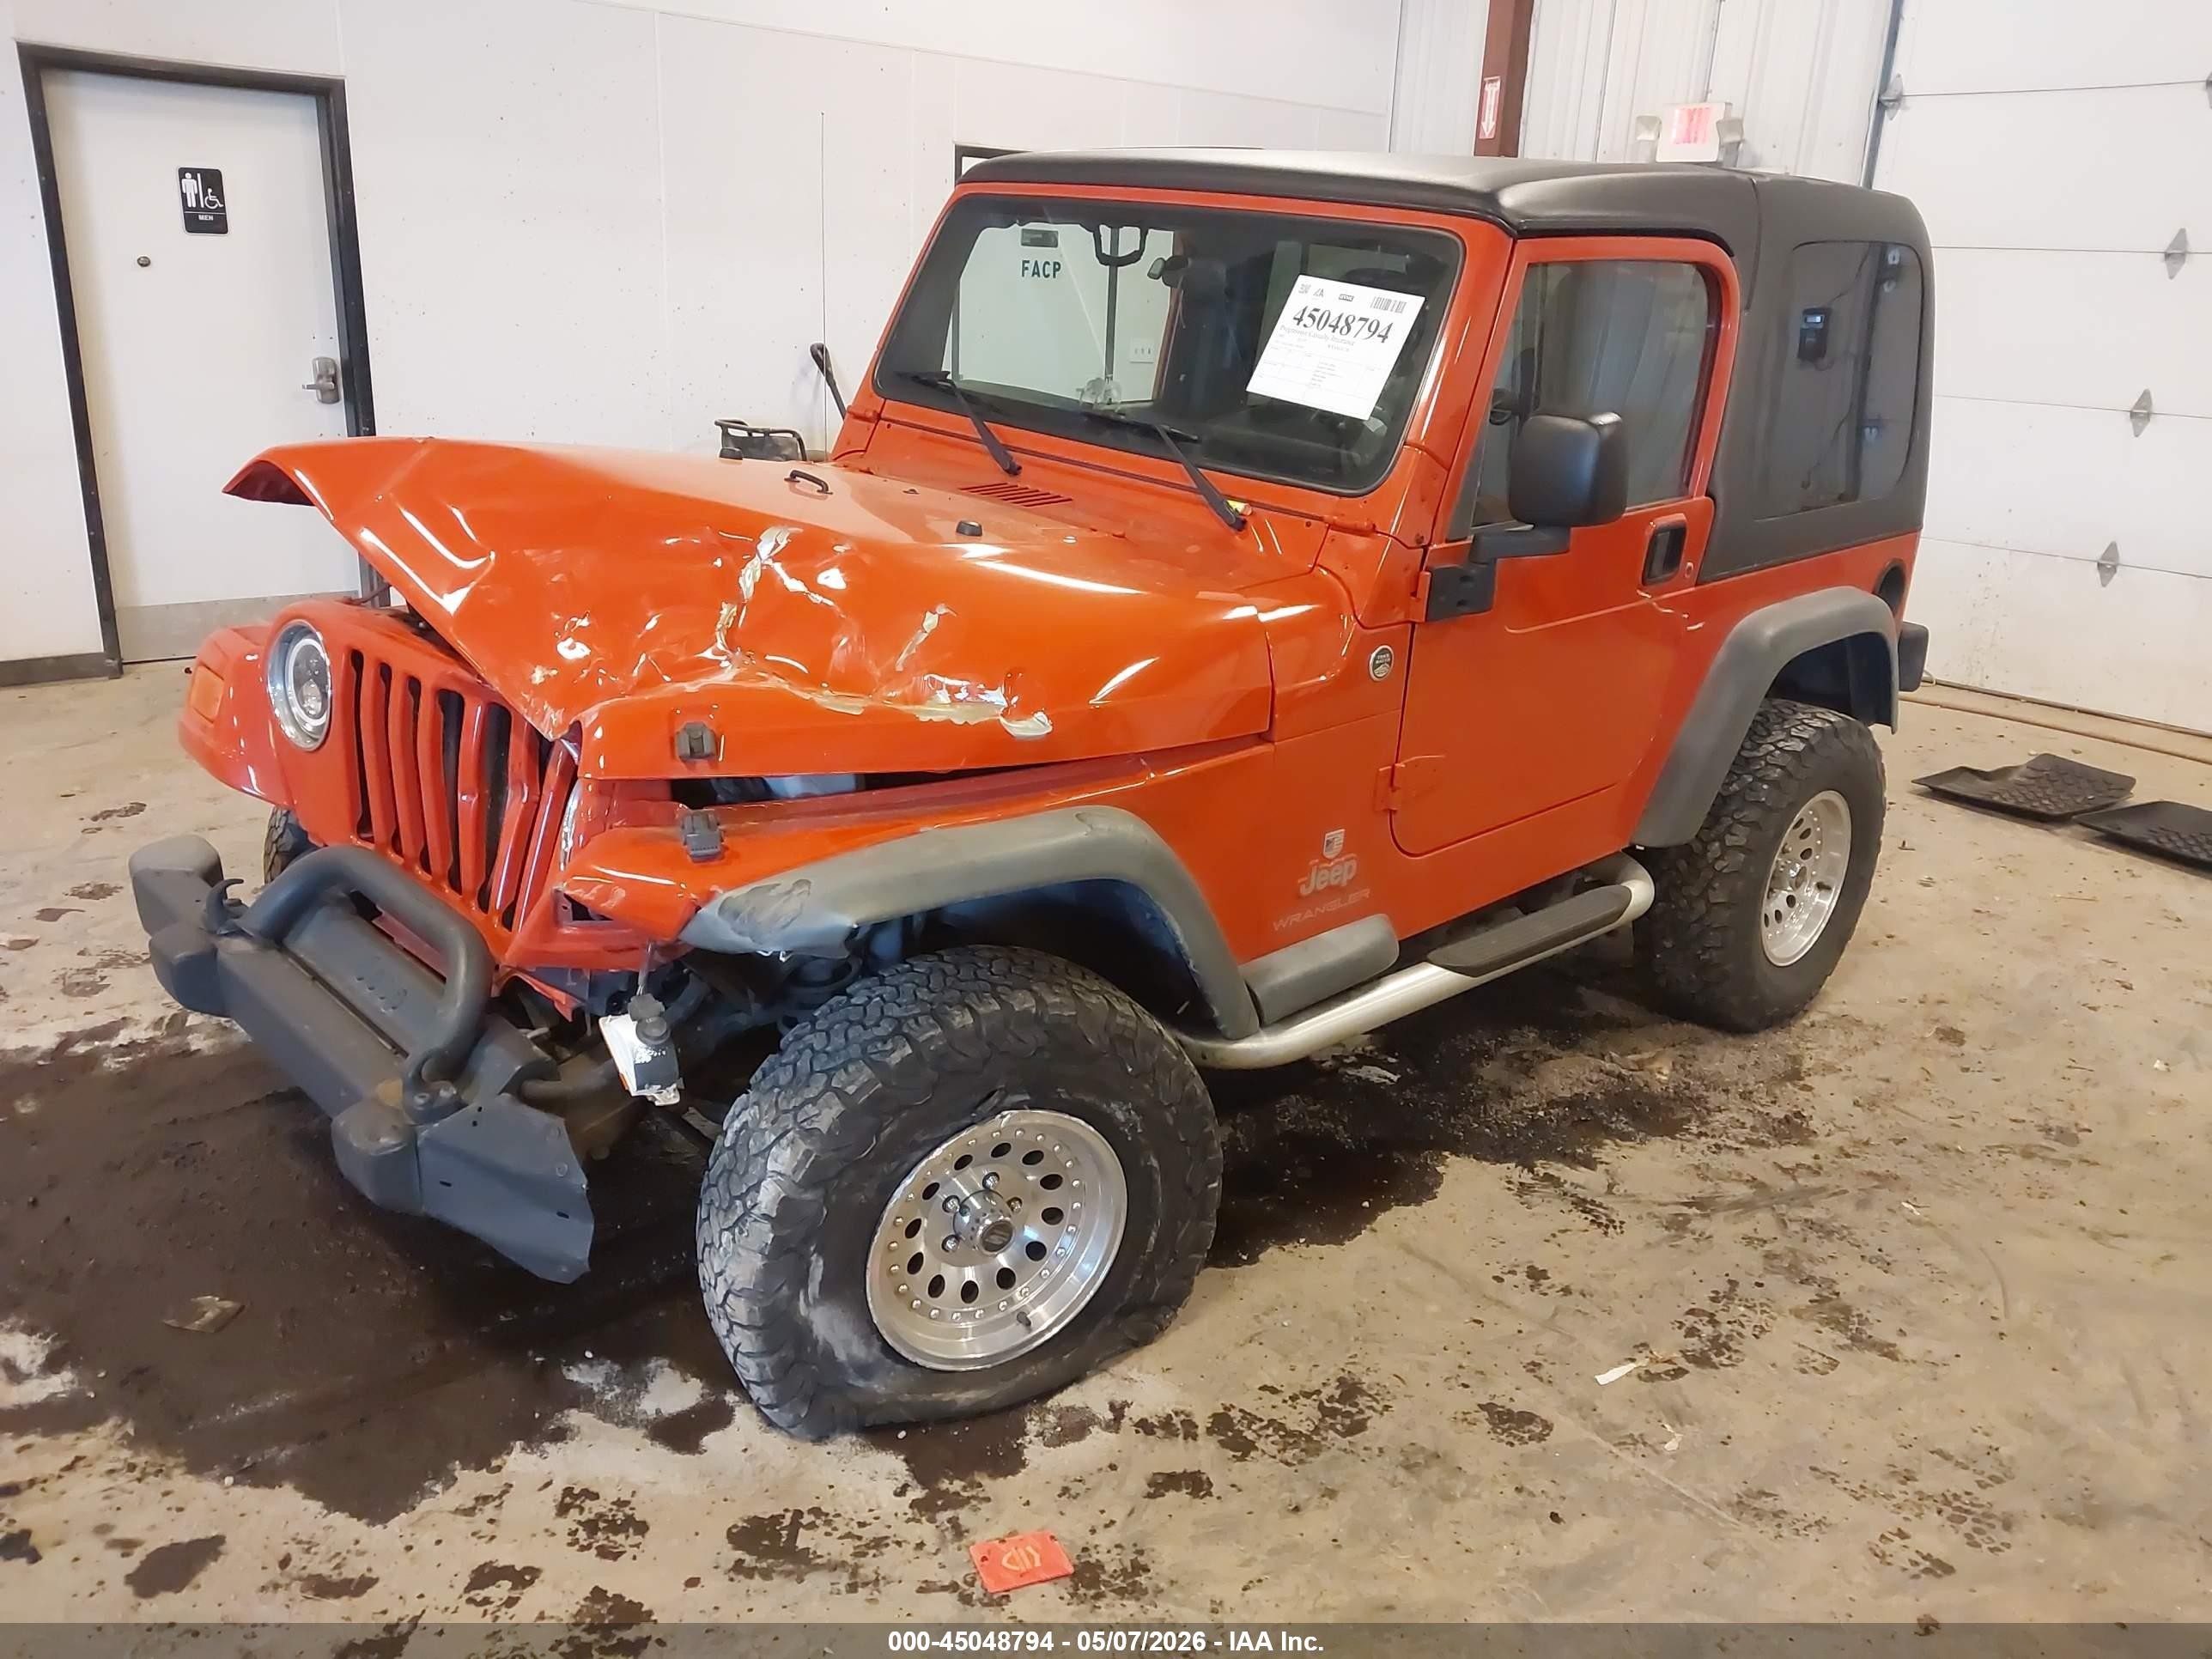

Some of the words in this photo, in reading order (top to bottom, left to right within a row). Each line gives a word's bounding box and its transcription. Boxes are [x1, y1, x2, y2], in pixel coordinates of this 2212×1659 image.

[1021, 259, 1061, 278] FACP
[1293, 306, 1393, 343] 45048794
[1298, 858, 1357, 896] Jeep
[1273, 888, 1370, 931] WRANGLER
